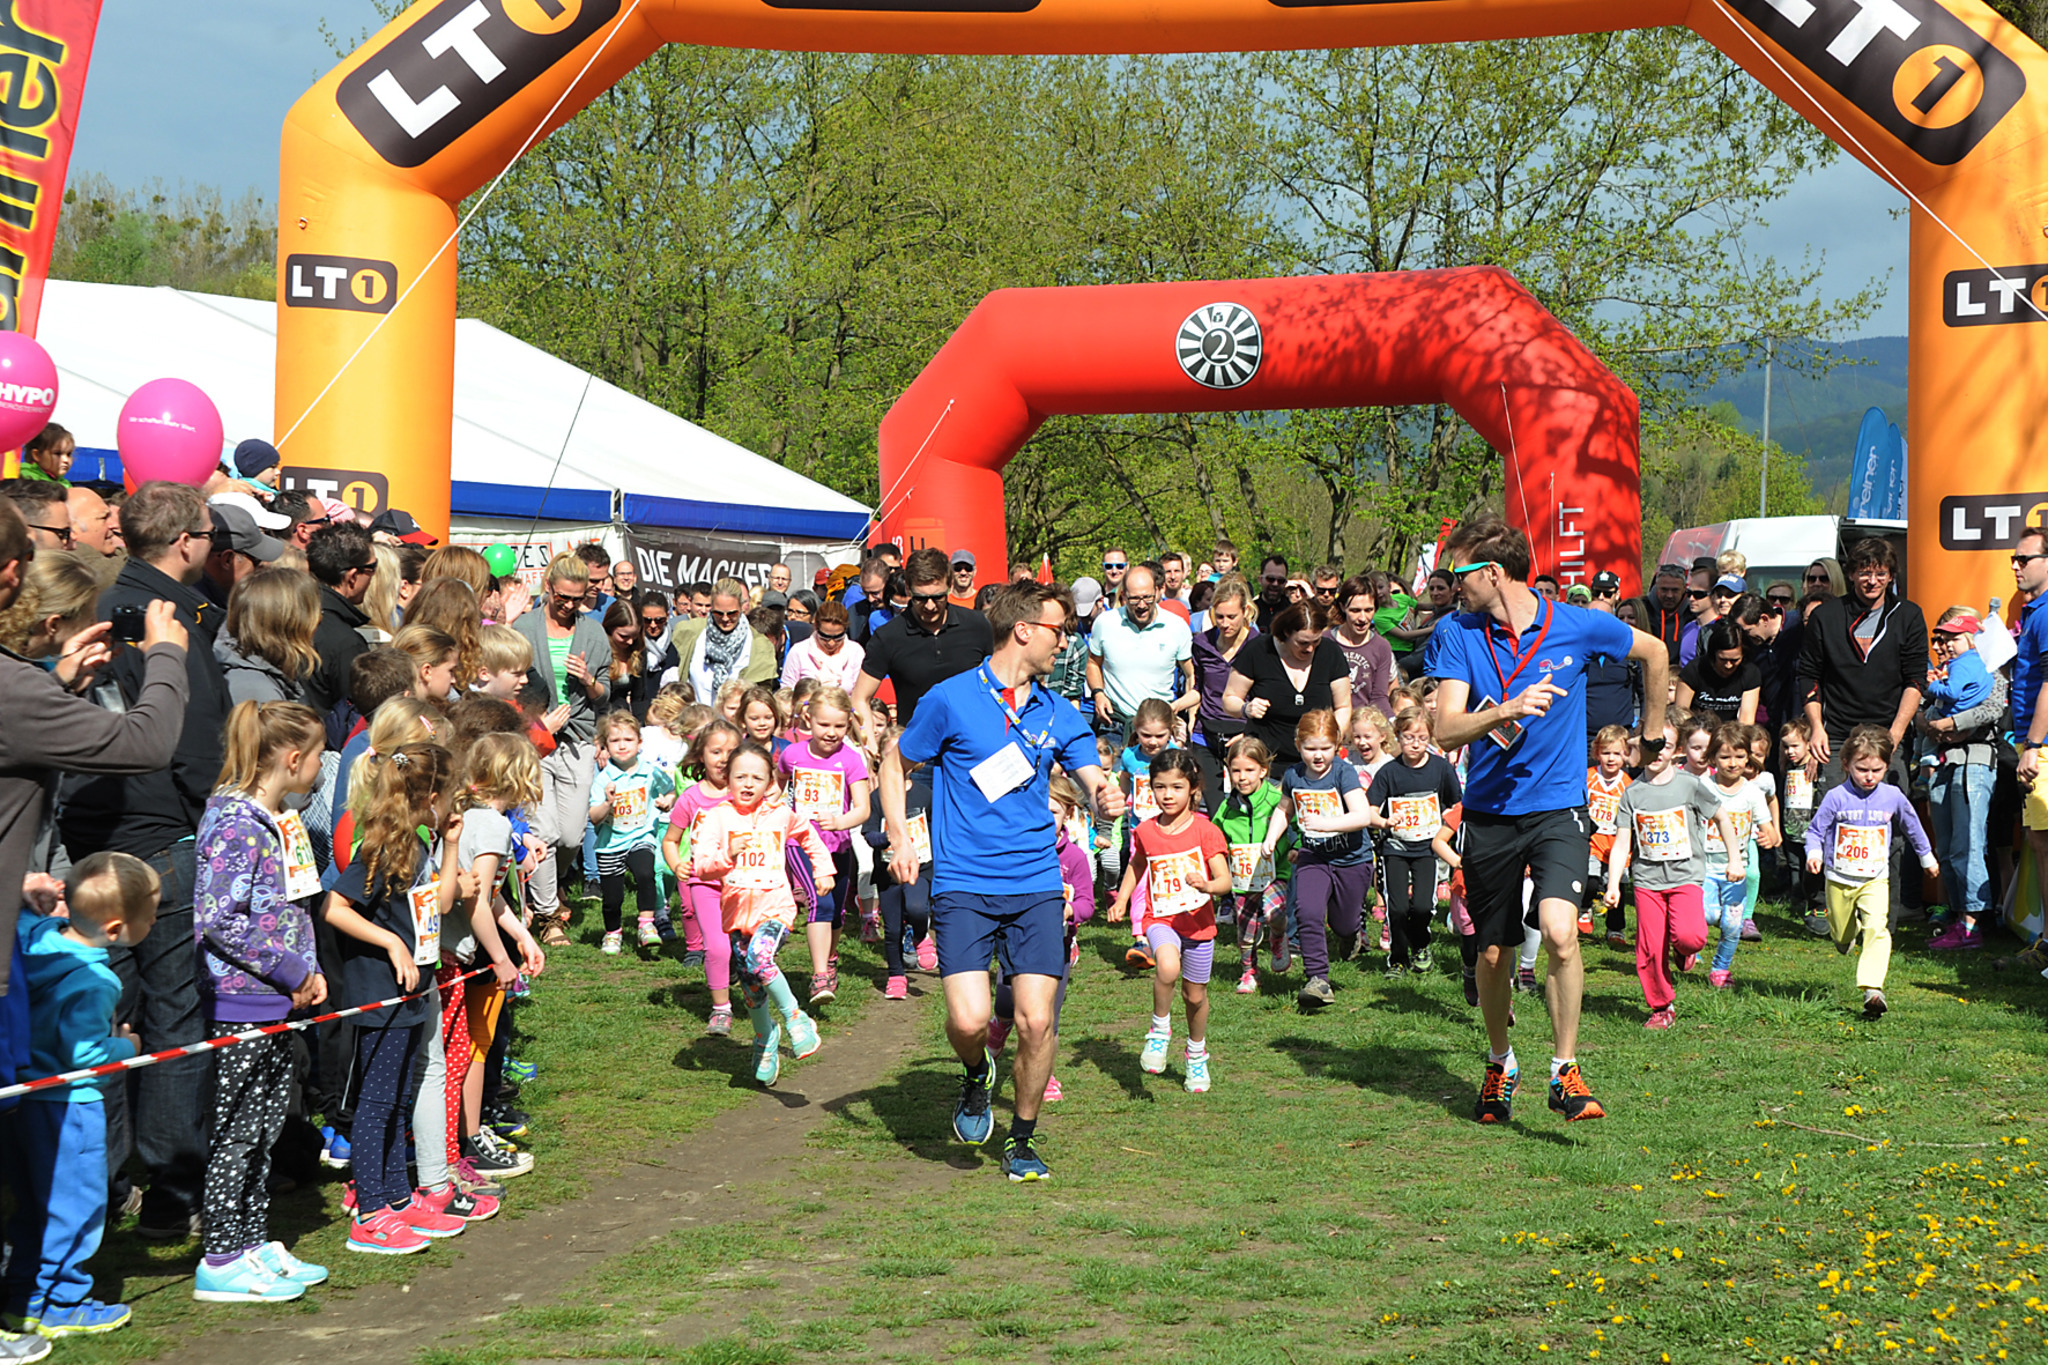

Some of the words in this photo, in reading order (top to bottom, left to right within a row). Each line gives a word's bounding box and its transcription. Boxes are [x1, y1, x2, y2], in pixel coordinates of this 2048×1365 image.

[292, 265, 374, 300] LT1
[0, 381, 55, 406] HYPO
[1558, 502, 1585, 590] HILFT
[635, 546, 674, 588] DIE
[804, 788, 819, 802] 93
[613, 804, 632, 816] 103
[1595, 808, 1613, 822] 178
[1646, 830, 1670, 844] 373
[740, 851, 766, 867] 102
[1846, 844, 1869, 859] 206
[1239, 862, 1253, 876] 76
[1164, 877, 1182, 894] 79
